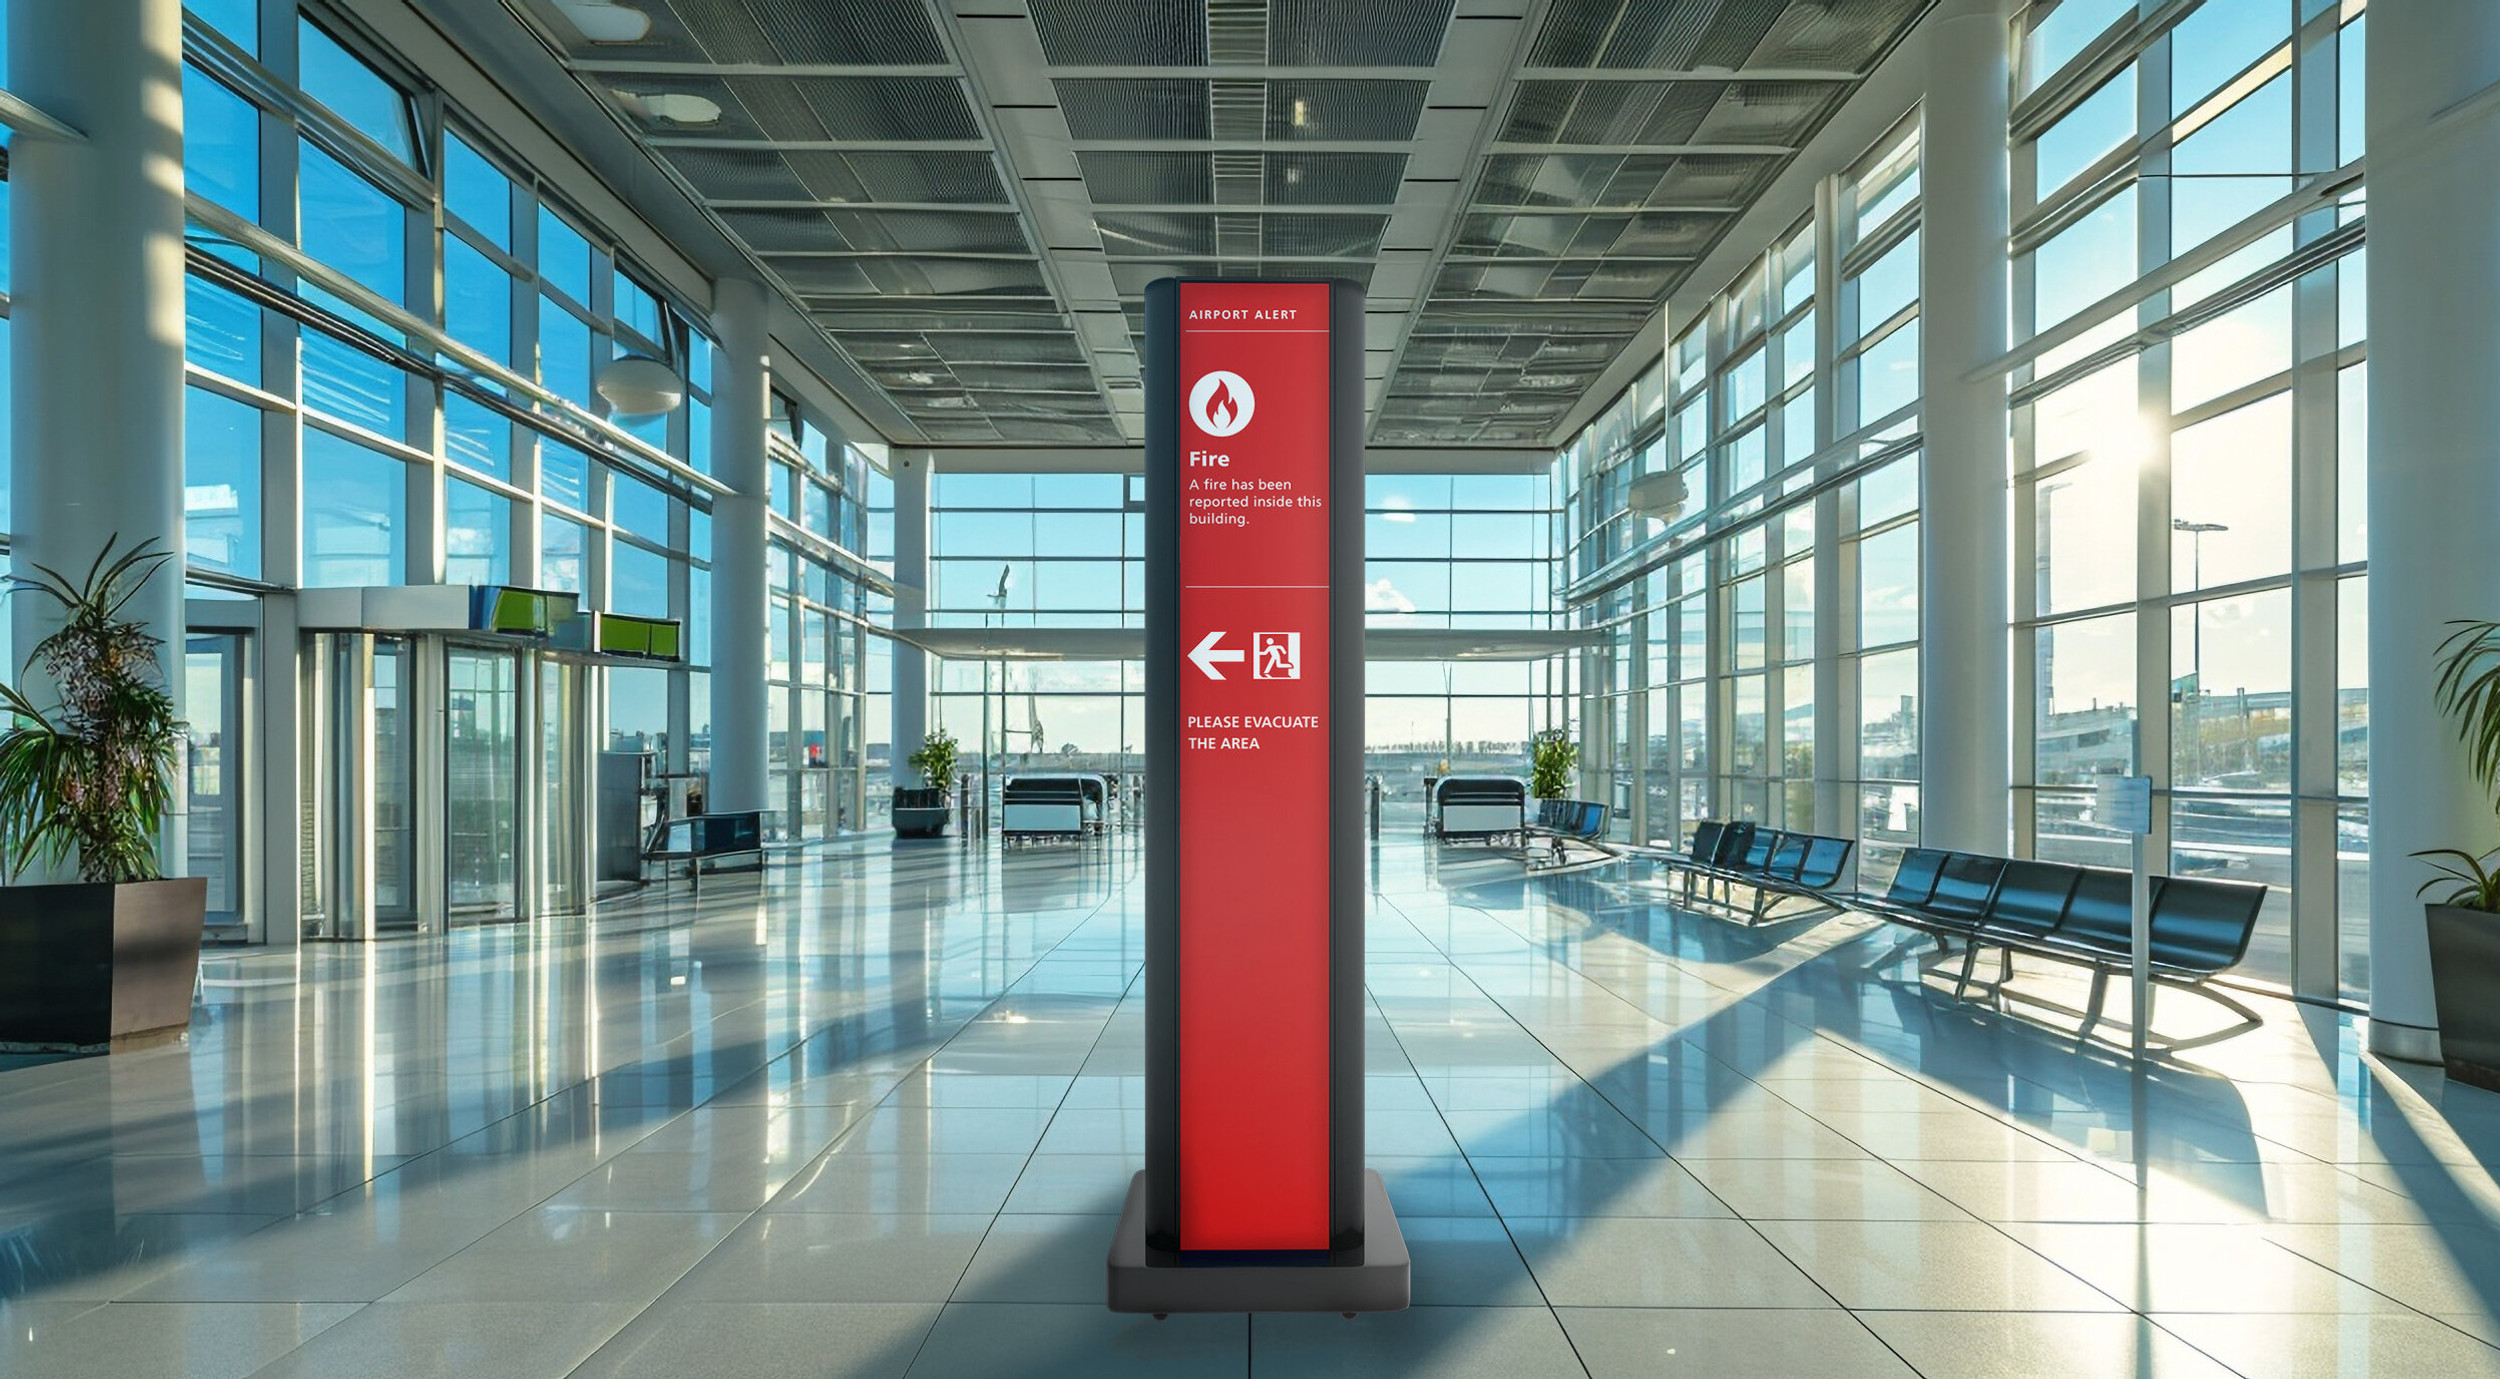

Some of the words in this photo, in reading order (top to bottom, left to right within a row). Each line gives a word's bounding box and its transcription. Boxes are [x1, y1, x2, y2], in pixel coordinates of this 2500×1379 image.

[1189, 310, 1248, 319] AIRPORT
[1255, 310, 1296, 319] ALERT
[1190, 451, 1230, 467] Fire
[1189, 479, 1199, 490] A
[1204, 478, 1227, 490] fire
[1232, 479, 1254, 490] has
[1259, 479, 1291, 490] been
[1190, 496, 1248, 510] reported
[1254, 496, 1293, 507] inside
[1297, 496, 1321, 507] this
[1190, 513, 1249, 527] building.
[1188, 716, 1239, 728] PLEASE
[1245, 716, 1318, 728] EVACUATE
[1188, 738, 1216, 749] THE
[1221, 738, 1260, 749] AREA
